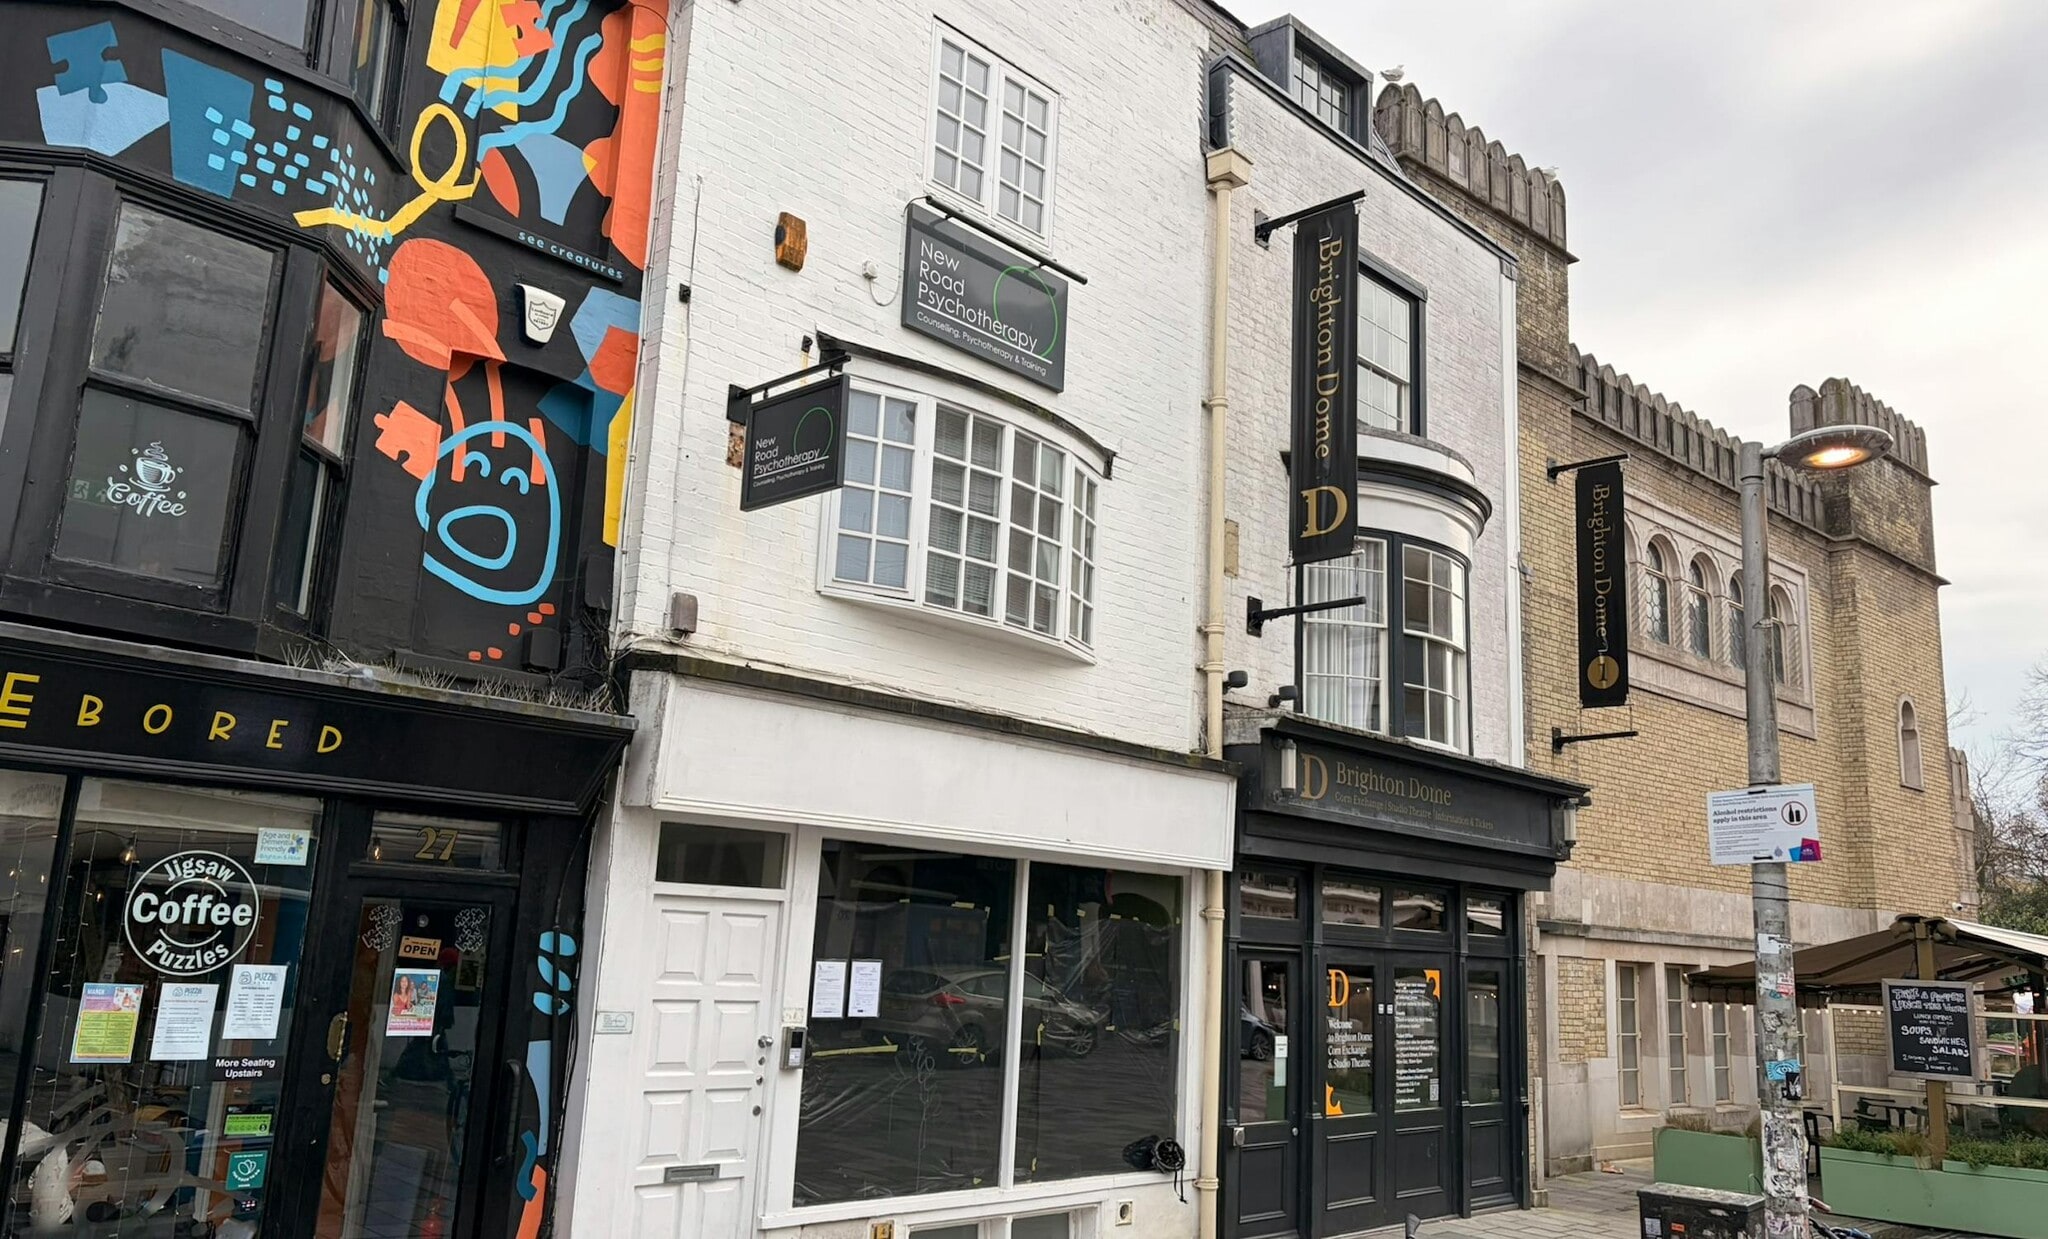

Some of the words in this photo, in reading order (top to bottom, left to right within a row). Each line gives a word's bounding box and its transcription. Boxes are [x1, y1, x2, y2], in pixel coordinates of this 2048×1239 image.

[518, 231, 545, 248] see
[551, 245, 623, 279] creatures
[920, 239, 960, 272] New
[919, 260, 965, 296] Road
[1308, 235, 1343, 368] Brighton
[918, 281, 1038, 353] Psychotherapy
[916, 311, 961, 339] Counselling,
[962, 331, 1014, 362] Psychotherapy
[1014, 354, 1020, 364] &
[1021, 356, 1047, 377] Training
[1314, 370, 1340, 458] Dome
[754, 446, 779, 463] Road
[755, 436, 777, 450] New
[753, 448, 820, 475] Psychotherapy
[107, 476, 187, 518] Coffee
[1300, 485, 1348, 538] D
[1586, 486, 1611, 573] Brighton
[1594, 576, 1612, 640] Dome
[76, 693, 344, 753] BORED
[1300, 752, 1329, 800] D
[1336, 761, 1405, 797] Brighton
[1409, 776, 1452, 806] Dome
[1334, 791, 1353, 804] Corn
[1353, 794, 1385, 811] Exchange
[1387, 801, 1408, 815] Studio
[1408, 805, 1432, 820] Theatre
[1713, 809, 1737, 817] Alcohol
[1737, 806, 1777, 815] restrictions
[261, 838, 293, 847] Dementia
[263, 831, 277, 840] Age
[278, 831, 291, 839] and
[414, 826, 458, 861] 27
[260, 846, 287, 854] Friendly
[164, 857, 236, 882] Jigsaw
[132, 891, 253, 927] Coffee
[145, 938, 229, 970] Puzzles
[403, 944, 437, 956] OPEN
[1328, 969, 1350, 1008] D
[1920, 991, 1929, 999] A
[1892, 999, 1922, 1012] LUNCH
[1328, 1033, 1334, 1041] to
[1334, 1032, 1357, 1044] Brighton
[1357, 1032, 1373, 1042] Dome
[1329, 1019, 1353, 1029] Welcome
[1901, 1024, 1933, 1036] SOUPS,
[215, 1059, 240, 1068] More
[241, 1058, 276, 1068] Seating
[1328, 1046, 1341, 1056] Corn
[1341, 1045, 1367, 1058] Exchange
[1328, 1060, 1333, 1068] &
[1333, 1059, 1350, 1068] Studio
[1350, 1058, 1371, 1068] Theatre
[1932, 1045, 1969, 1058] SALADS
[225, 1069, 263, 1079] Upstairs
